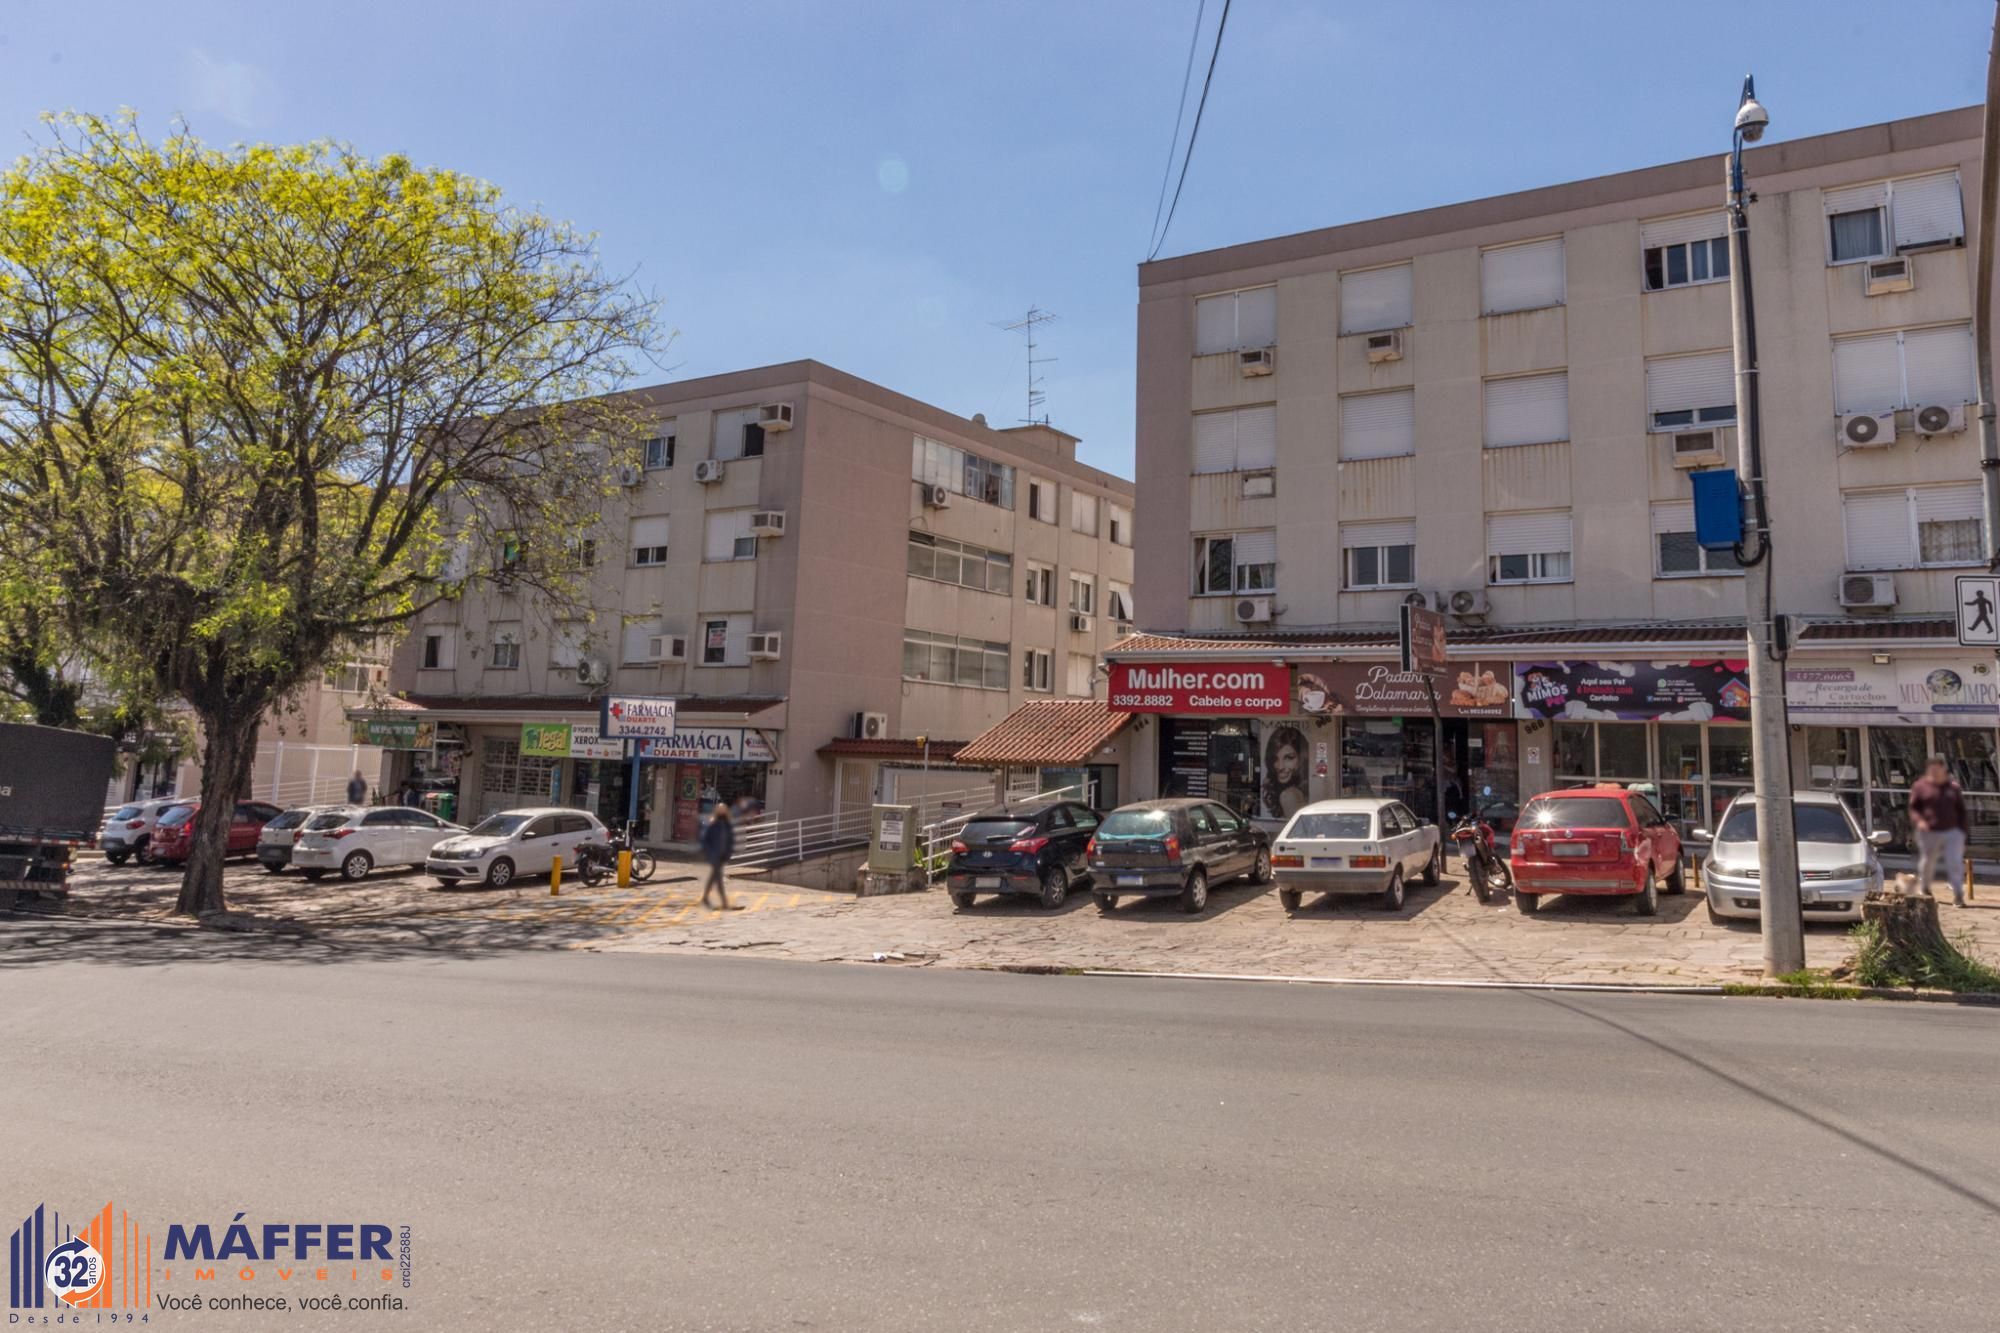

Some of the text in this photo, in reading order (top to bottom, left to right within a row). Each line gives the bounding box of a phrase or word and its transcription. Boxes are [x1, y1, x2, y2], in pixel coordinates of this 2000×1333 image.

[1128, 668, 1265, 690] Mulher.com
[1815, 683, 1873, 693] Recarga de
[1527, 684, 1569, 703] MIMOS
[1829, 693, 1887, 701] Cartuchos
[1113, 695, 1282, 710] 3392.8882 Cabelo e corpo
[627, 702, 673, 717] FARMÁCIA
[619, 725, 666, 735] 3344.2742
[574, 735, 600, 745] XEROX
[654, 749, 699, 758] DUARTE
